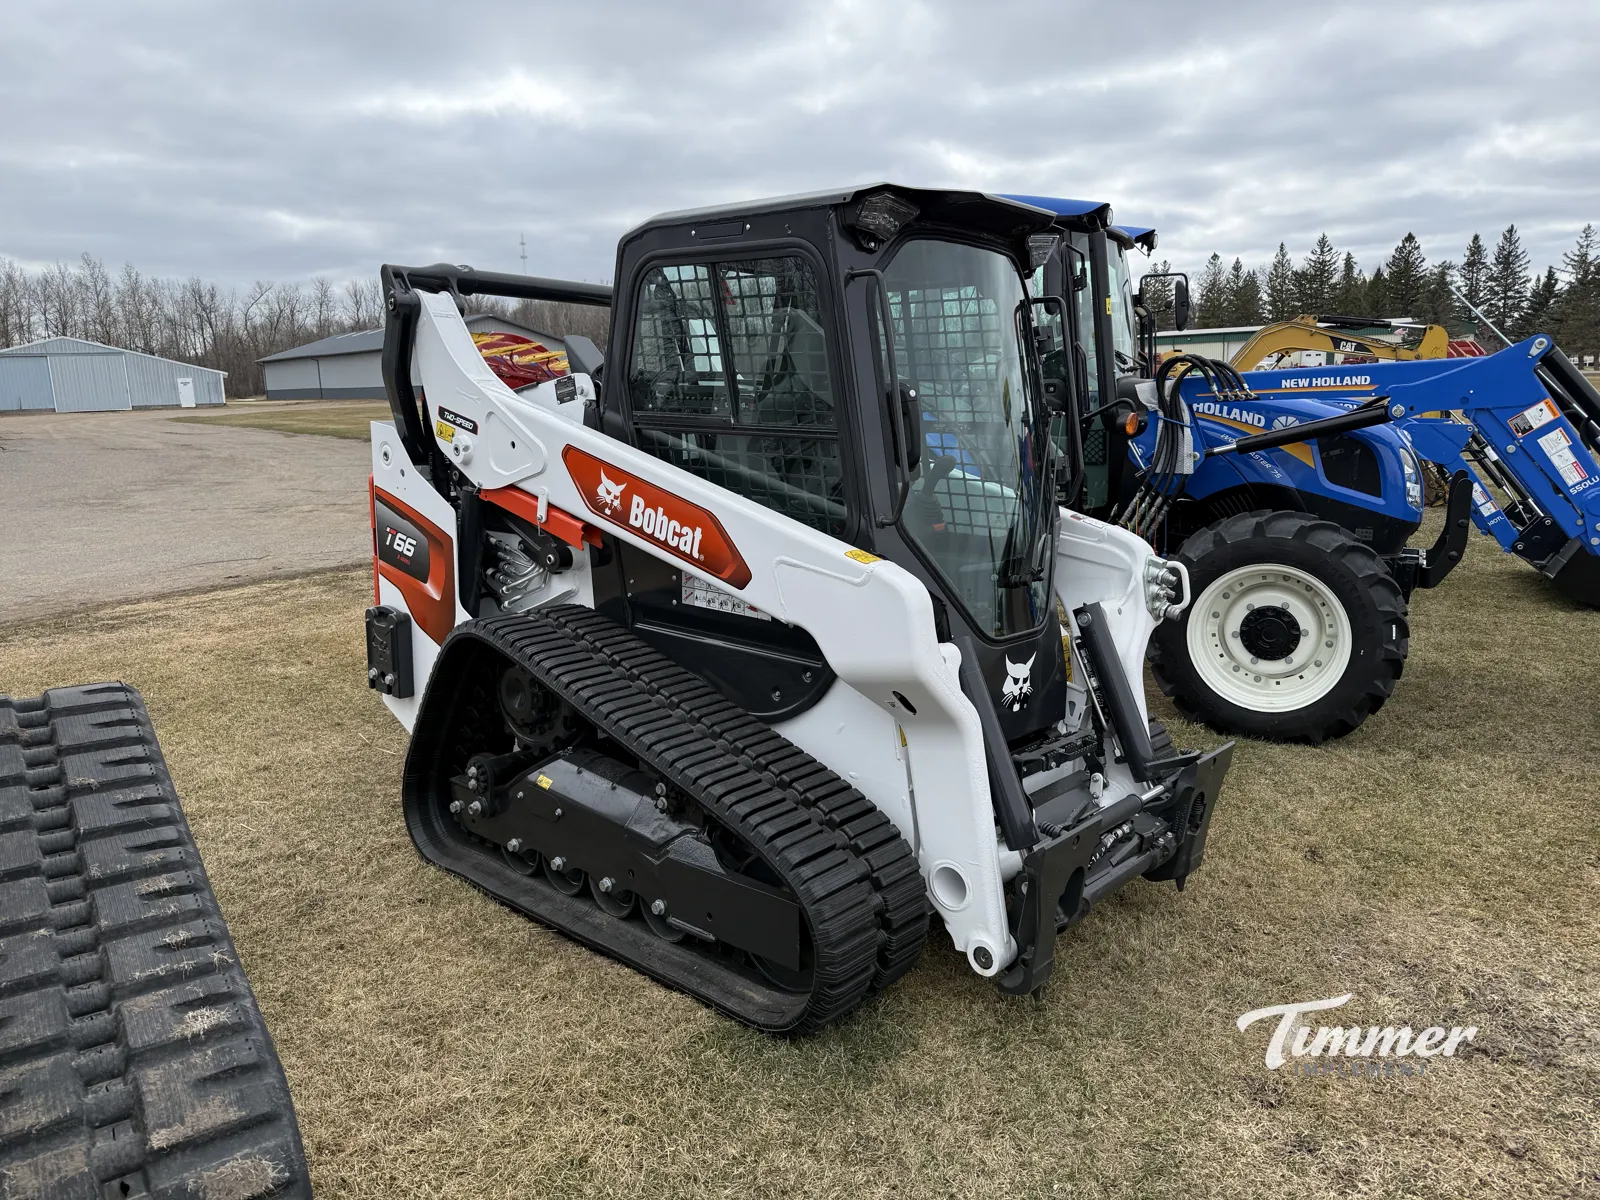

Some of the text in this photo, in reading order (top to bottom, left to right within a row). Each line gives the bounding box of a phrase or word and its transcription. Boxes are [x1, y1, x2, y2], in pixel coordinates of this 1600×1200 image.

[1340, 341, 1357, 352] CAT
[1281, 375, 1371, 388] NEW HOLLAND
[444, 411, 474, 430] TWO-SPEED
[1192, 402, 1266, 428] HOLLAND
[1271, 468, 1283, 479] 75
[1569, 475, 1600, 495] 550LU
[629, 493, 702, 559] Bobcat
[386, 526, 418, 557] T66
